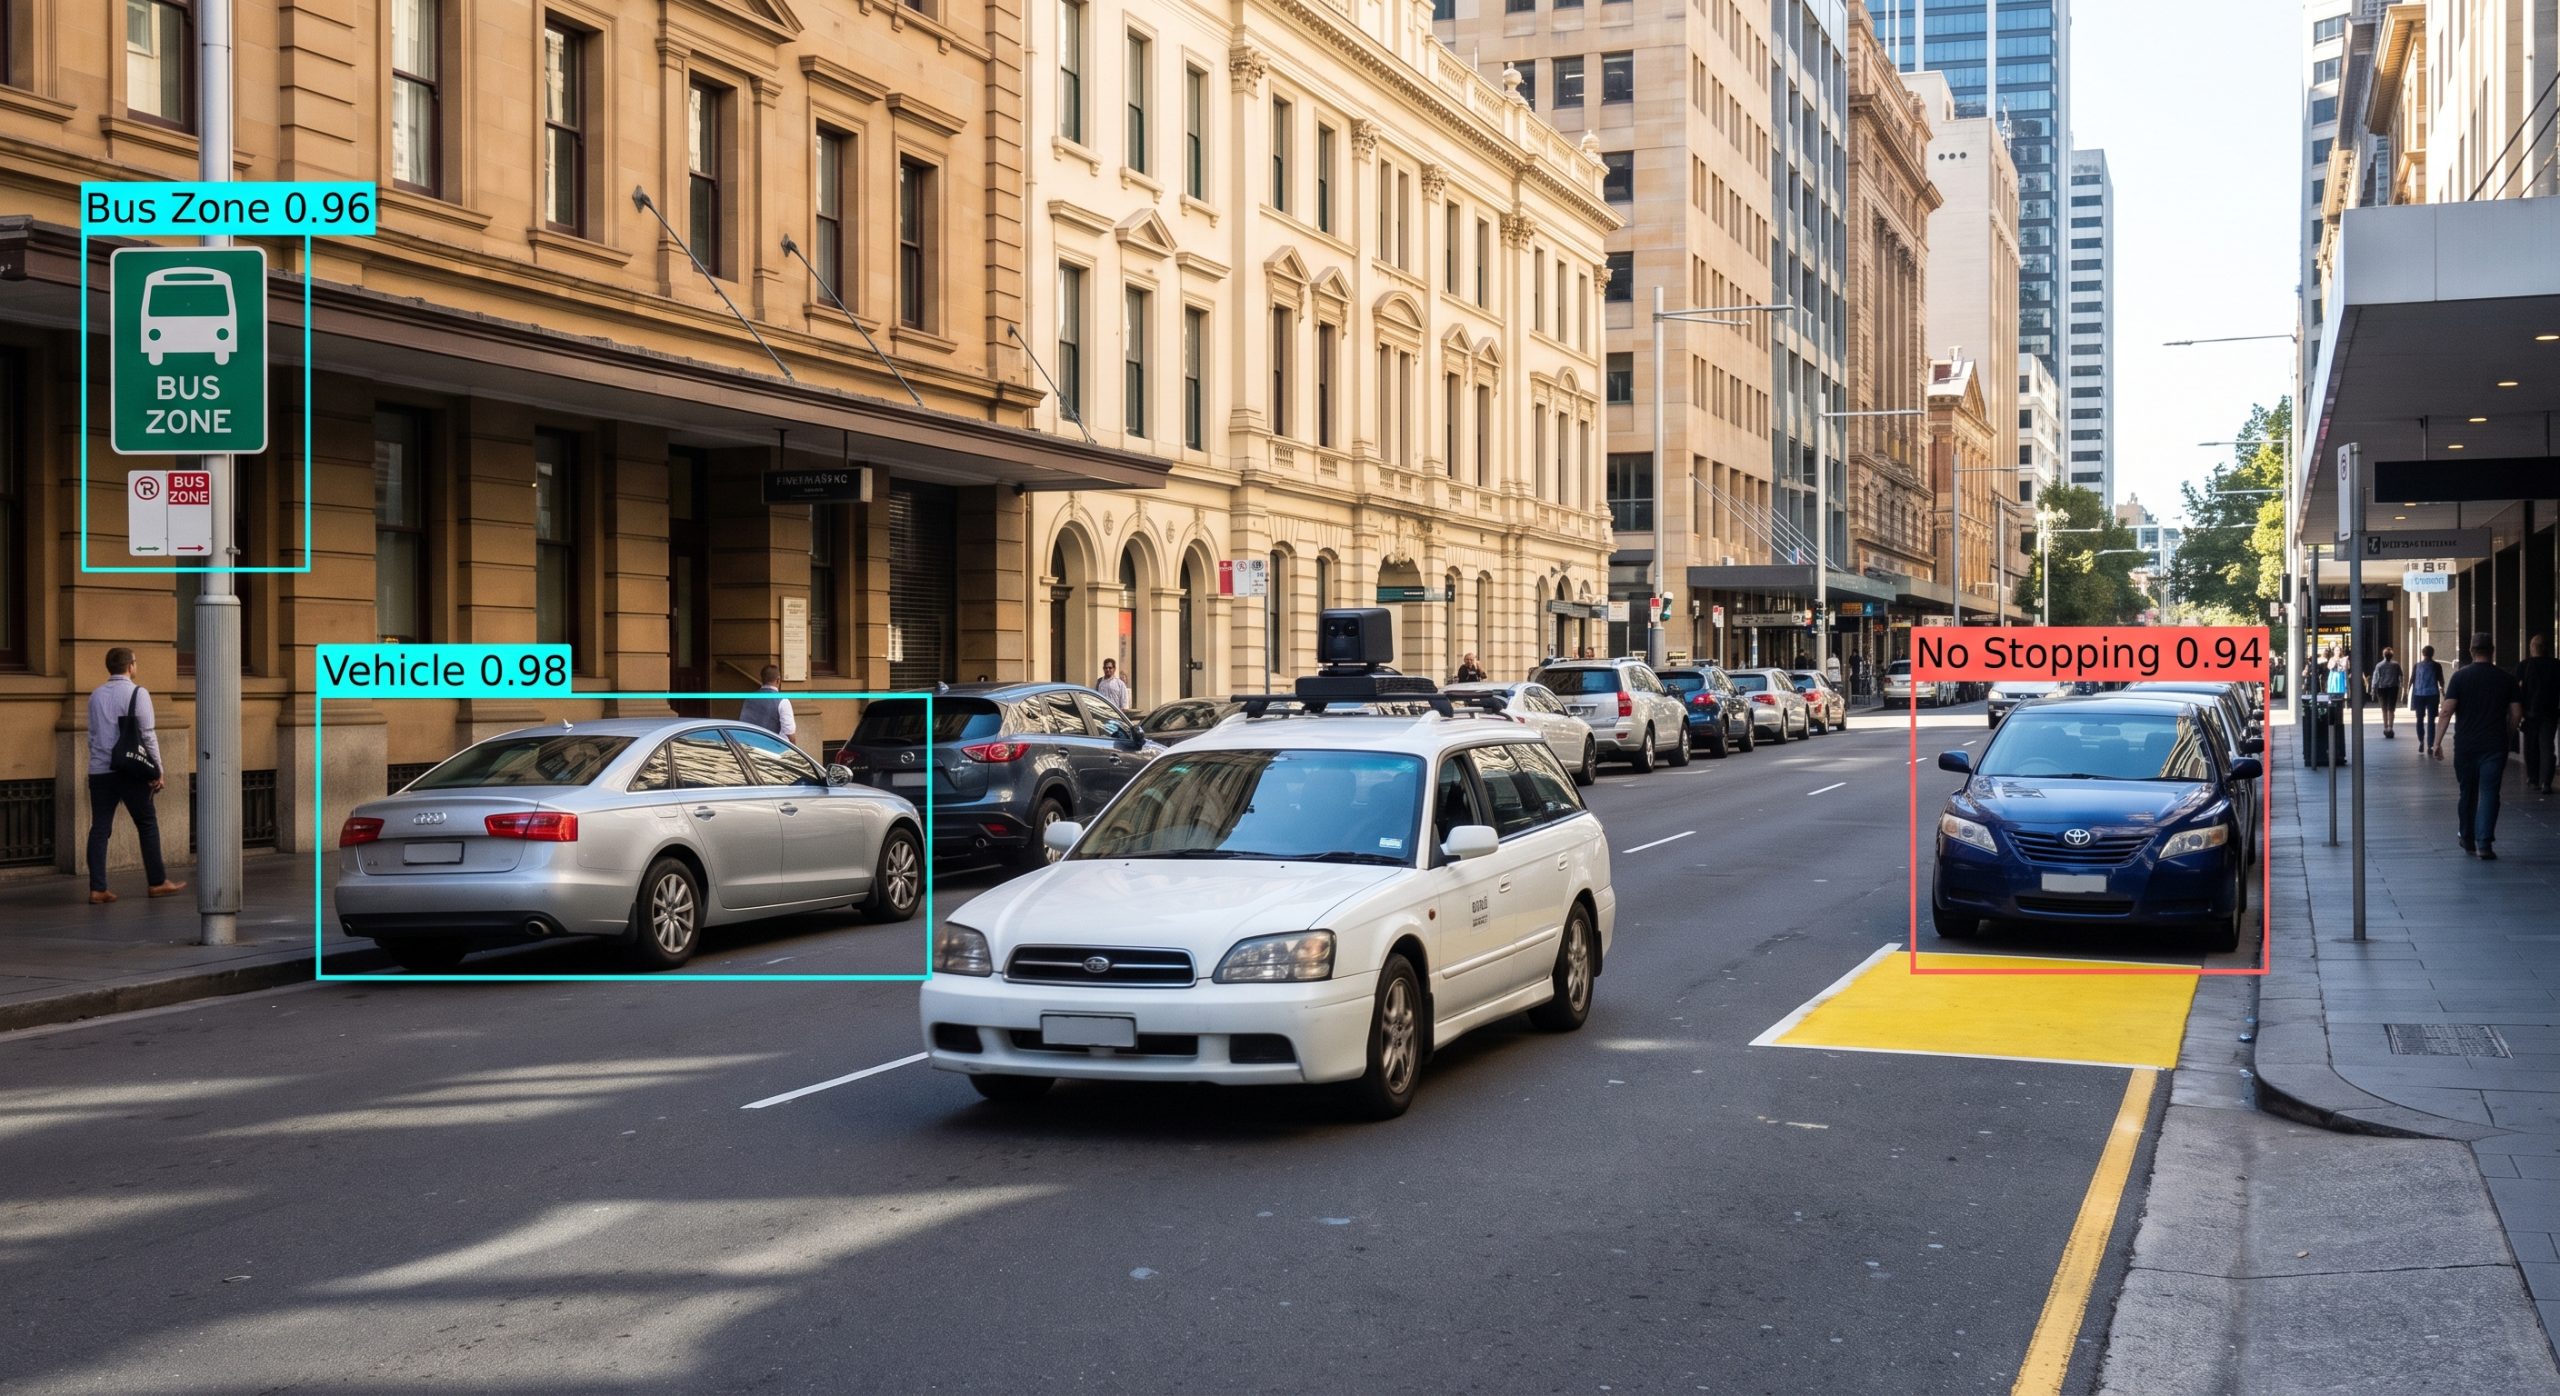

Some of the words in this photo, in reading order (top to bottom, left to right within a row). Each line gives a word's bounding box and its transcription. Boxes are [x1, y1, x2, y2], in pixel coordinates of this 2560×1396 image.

[156, 375, 221, 400] BUS
[145, 409, 232, 434] ZONE
[173, 475, 205, 488] BUS
[169, 491, 209, 503] ZONE
